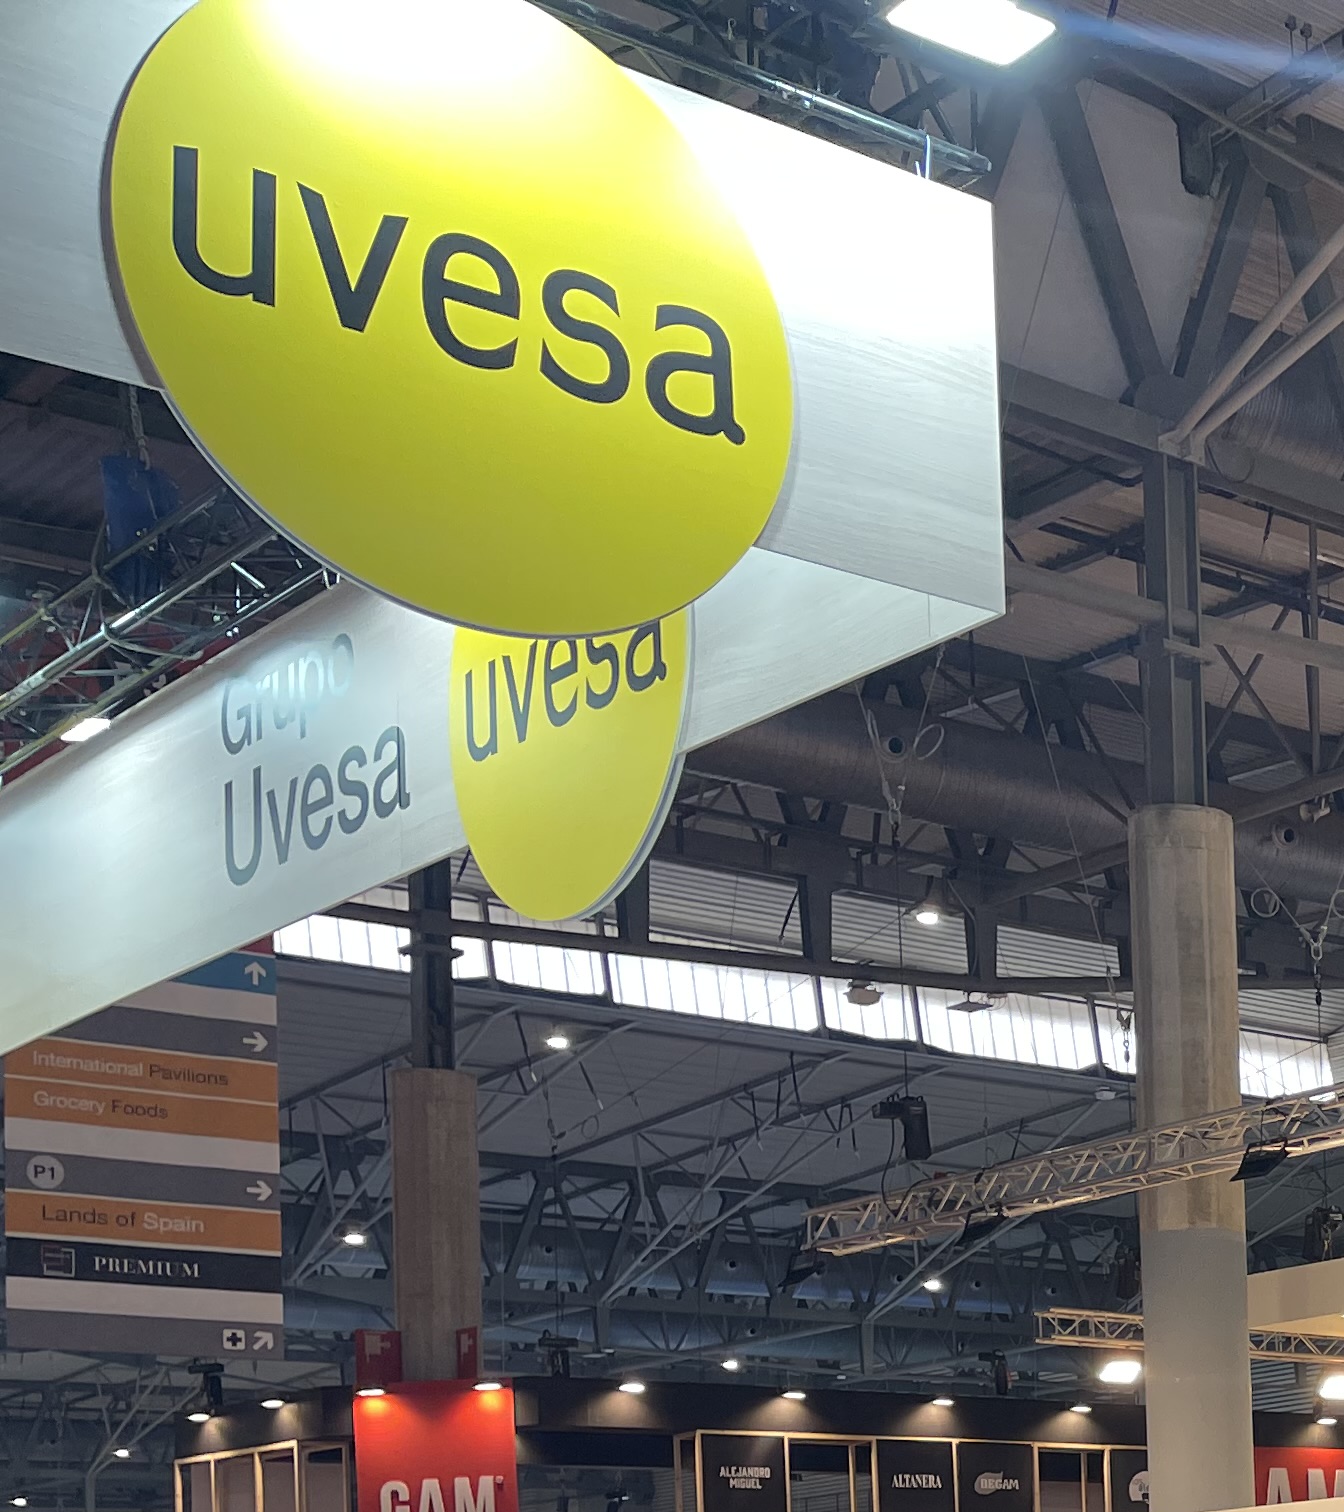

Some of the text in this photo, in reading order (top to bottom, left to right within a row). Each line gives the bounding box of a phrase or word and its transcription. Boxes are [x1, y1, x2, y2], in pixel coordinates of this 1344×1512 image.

[172, 145, 746, 445] uvesa
[220, 633, 354, 755] Grupo
[465, 620, 666, 762] uvesa
[224, 725, 410, 886] Uvesa
[33, 1050, 229, 1086] International Pavilions
[33, 1090, 169, 1119] Grocery Foods
[33, 1164, 55, 1180] P1
[42, 1204, 205, 1234] Lands of Spain
[93, 1255, 201, 1278] PREMIUM
[719, 1466, 771, 1478] ALEJANDRO
[729, 1478, 762, 1489] MIGUEL
[891, 1473, 942, 1489] ALTANERA
